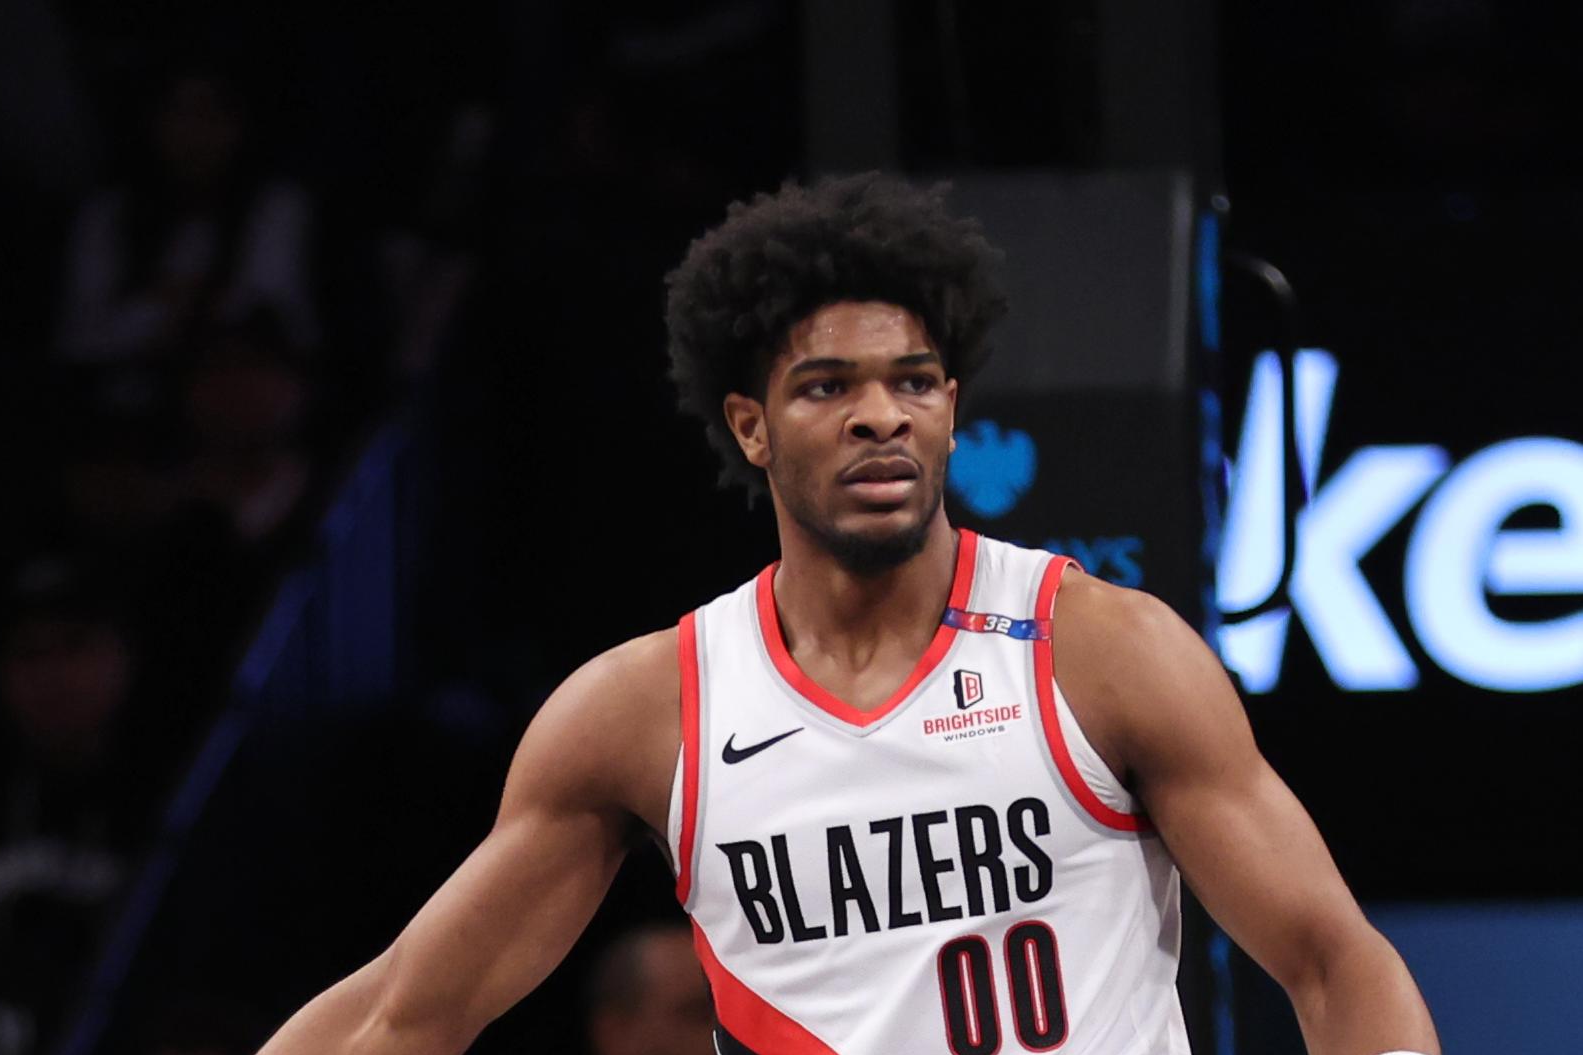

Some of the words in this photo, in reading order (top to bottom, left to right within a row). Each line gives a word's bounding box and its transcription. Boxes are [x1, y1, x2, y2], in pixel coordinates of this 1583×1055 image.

[1218, 347, 1583, 695] ke
[983, 615, 1012, 634] 32
[923, 704, 1022, 735] BRIGHTSIDE
[943, 725, 1005, 742] WINDOWS
[715, 796, 1054, 945] BLAZERS
